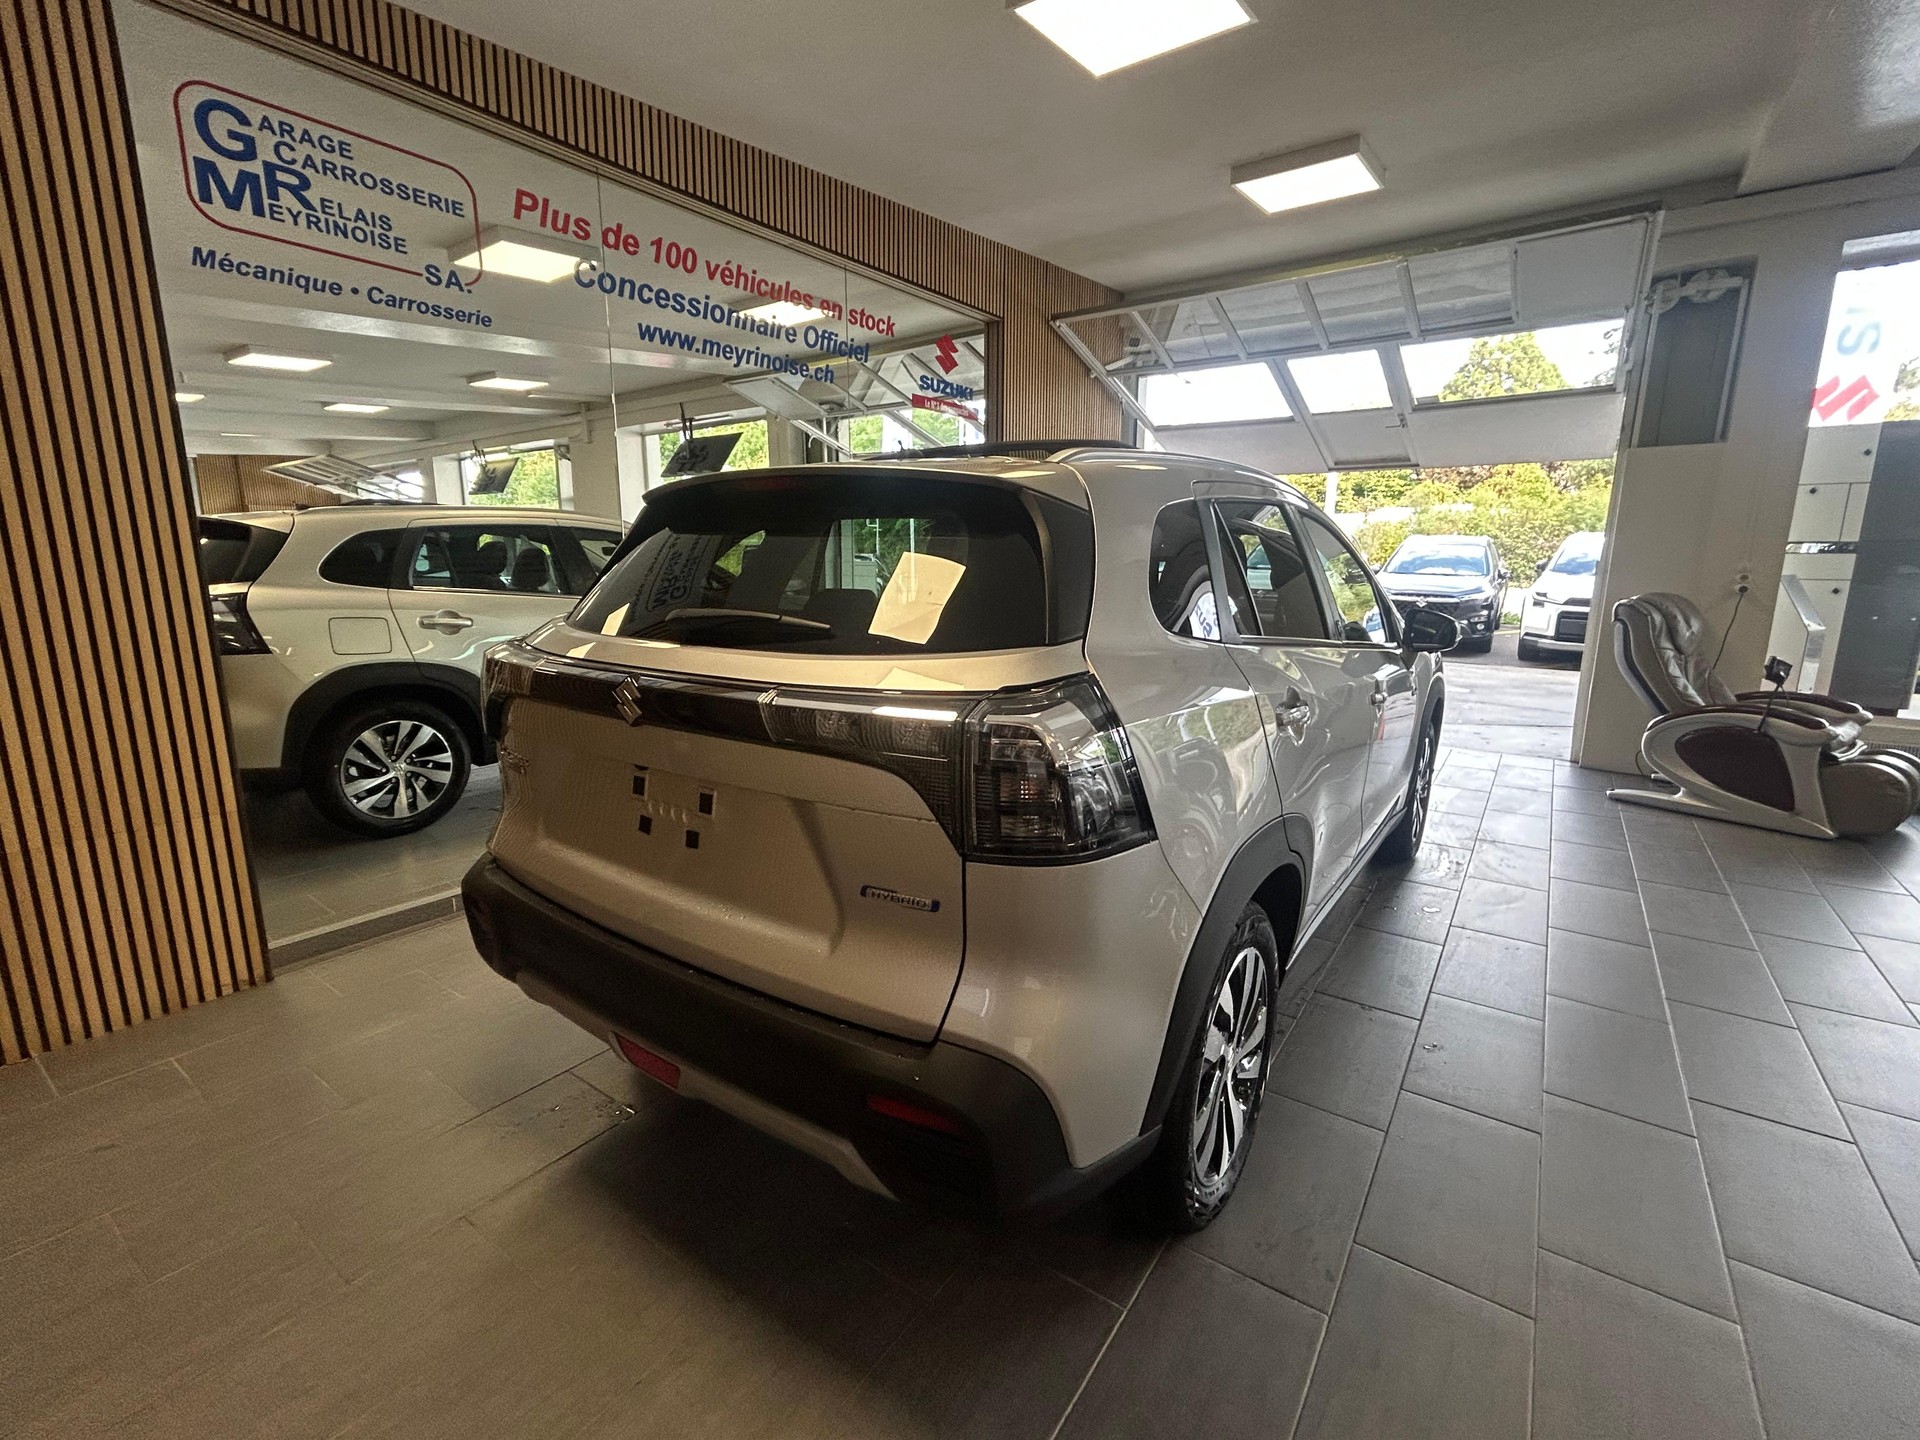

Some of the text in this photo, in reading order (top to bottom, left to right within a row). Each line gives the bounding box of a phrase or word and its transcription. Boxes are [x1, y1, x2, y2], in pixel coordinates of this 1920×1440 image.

[273, 139, 465, 218] CARROSSERIE
[191, 246, 493, 328] Mécanique Carrosserie
[513, 188, 896, 337] Plus de 100 véhicules en stock
[574, 258, 870, 363] Concessionnaire Officiel
[637, 322, 835, 384] www.meyrinoise.ch
[919, 374, 974, 401] SUZUKI
[870, 890, 928, 908] HYBRID
